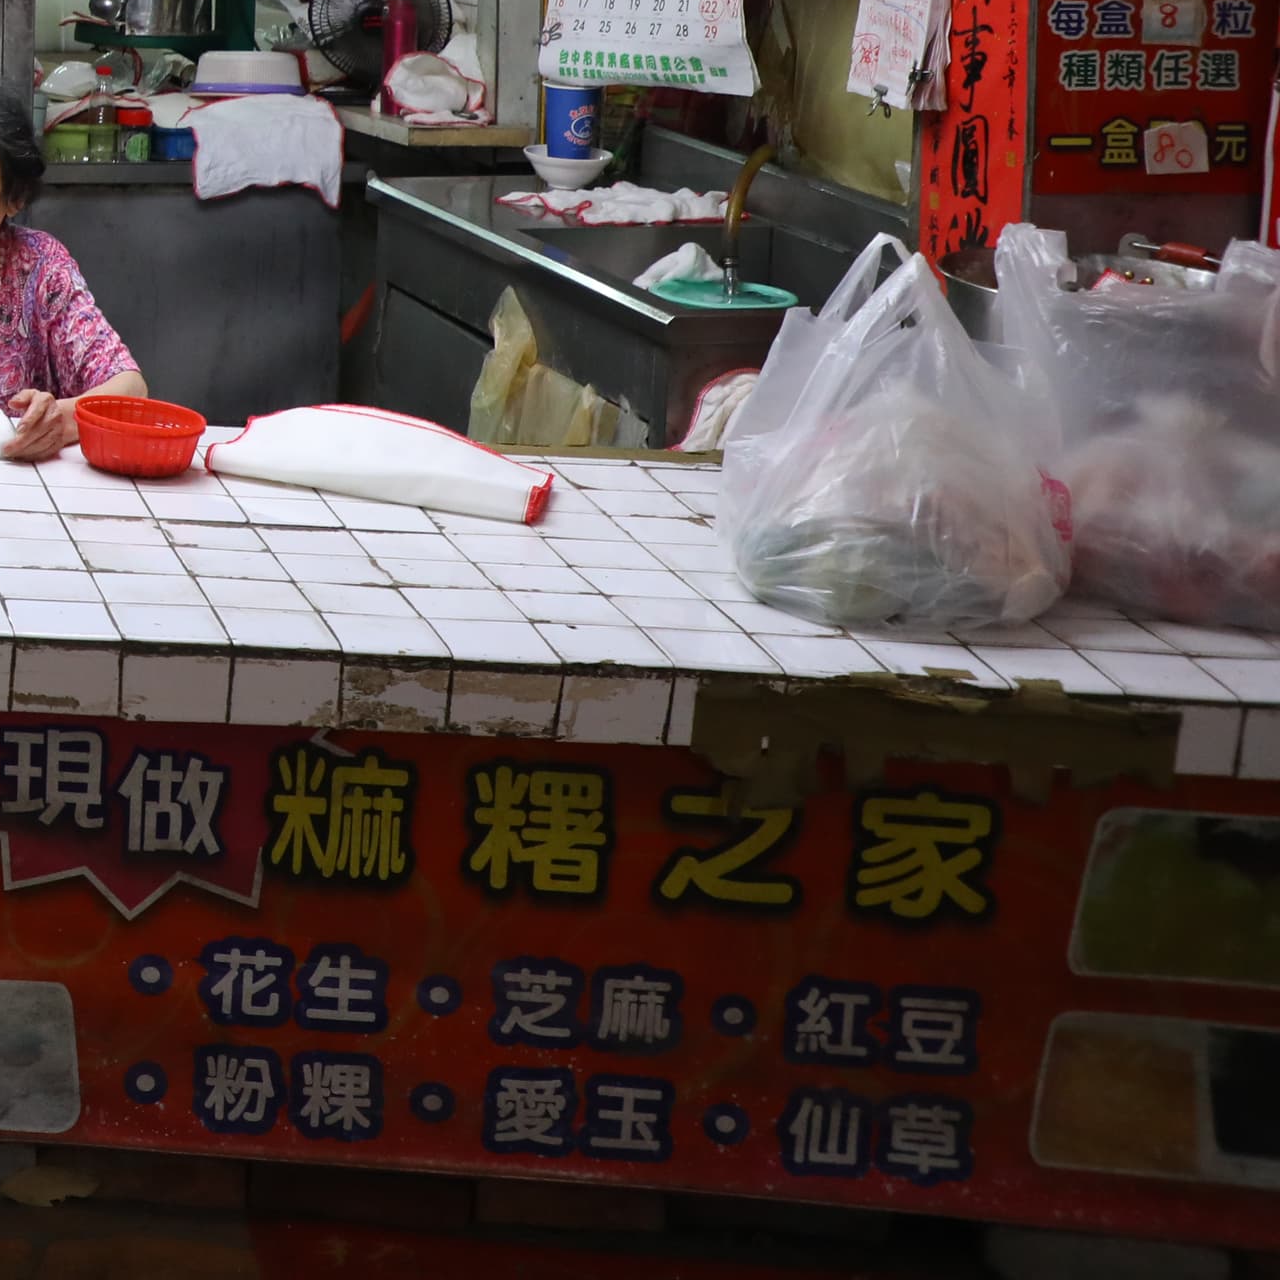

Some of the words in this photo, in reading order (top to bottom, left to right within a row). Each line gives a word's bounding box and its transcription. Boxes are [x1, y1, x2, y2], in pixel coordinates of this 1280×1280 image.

[573, 19, 585, 31] 24
[599, 20, 611, 33] 25
[625, 21, 637, 35] 26
[649, 23, 662, 36] 27
[675, 24, 689, 37] 28
[704, 25, 718, 39] 29
[653, 0, 665, 12] 20
[678, 0, 689, 12] 21
[704, 0, 717, 14] 22
[1060, 50, 1240, 91] 種類任選
[1, 729, 227, 857] 現做
[209, 947, 377, 1024] 花生
[502, 968, 673, 1044] 芝麻
[795, 987, 969, 1068] 紅豆
[202, 1054, 375, 1133] 粉粿
[493, 1078, 665, 1154] 愛玉
[787, 1097, 963, 1175] 仙草
